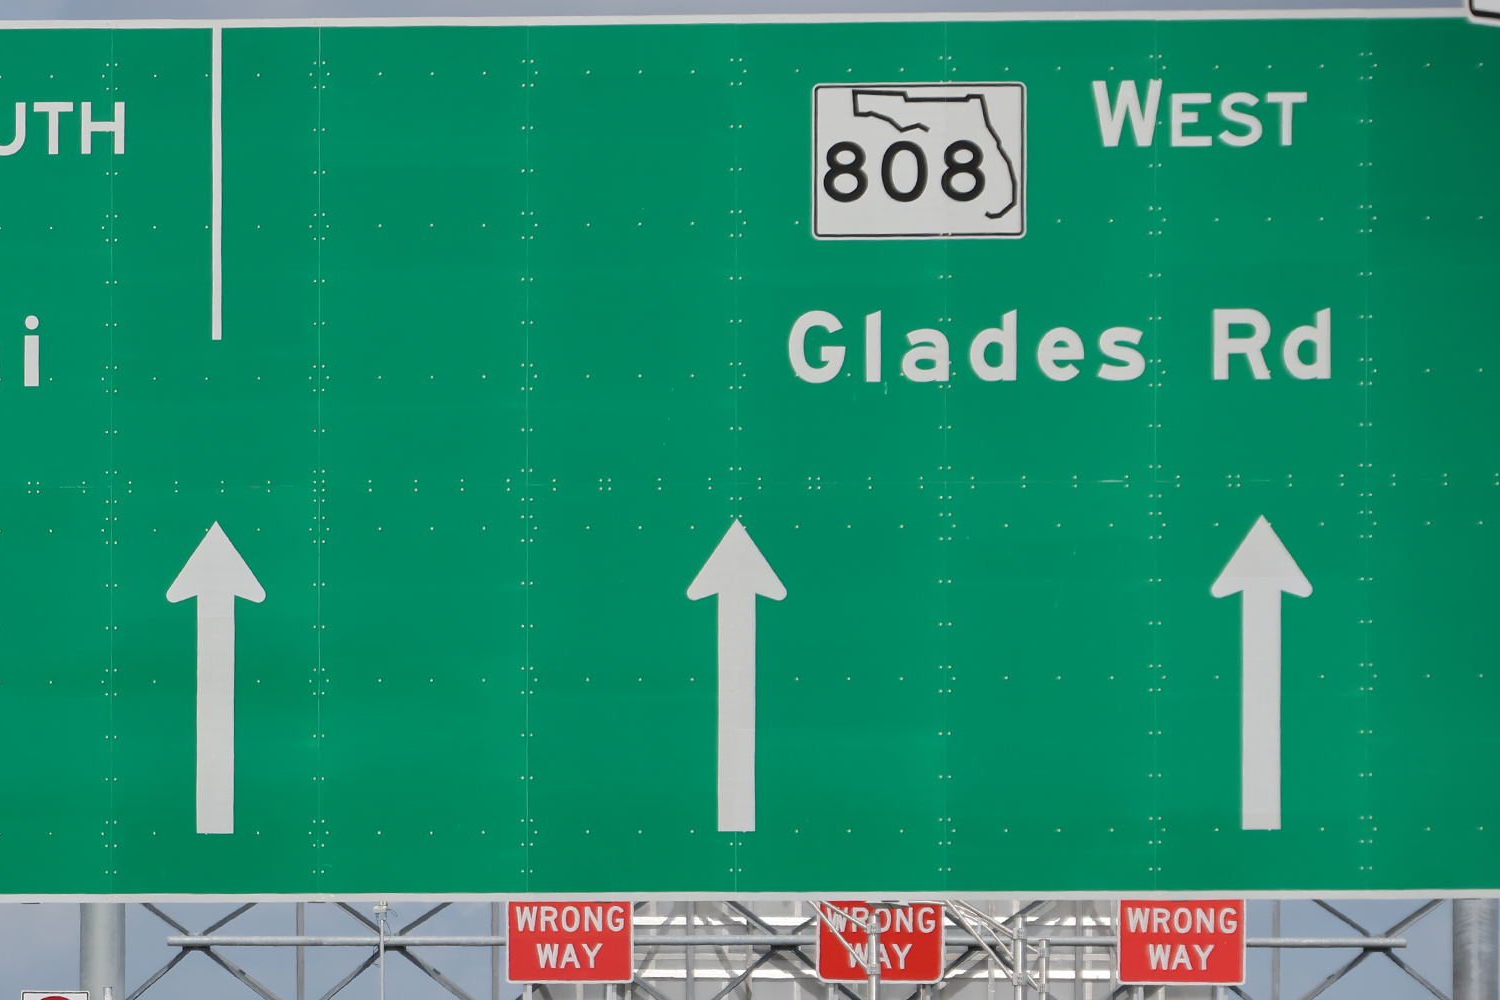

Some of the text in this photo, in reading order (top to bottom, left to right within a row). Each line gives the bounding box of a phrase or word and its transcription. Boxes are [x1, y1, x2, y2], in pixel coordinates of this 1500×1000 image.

[1092, 79, 1308, 147] WEST
[823, 140, 987, 203] 808
[788, 307, 1331, 384] Glades Rd
[515, 906, 625, 932] WRONG
[826, 907, 936, 933] WRONG
[1127, 907, 1238, 934] WRONG
[536, 943, 603, 969] WAY
[1148, 944, 1215, 970] WAY
